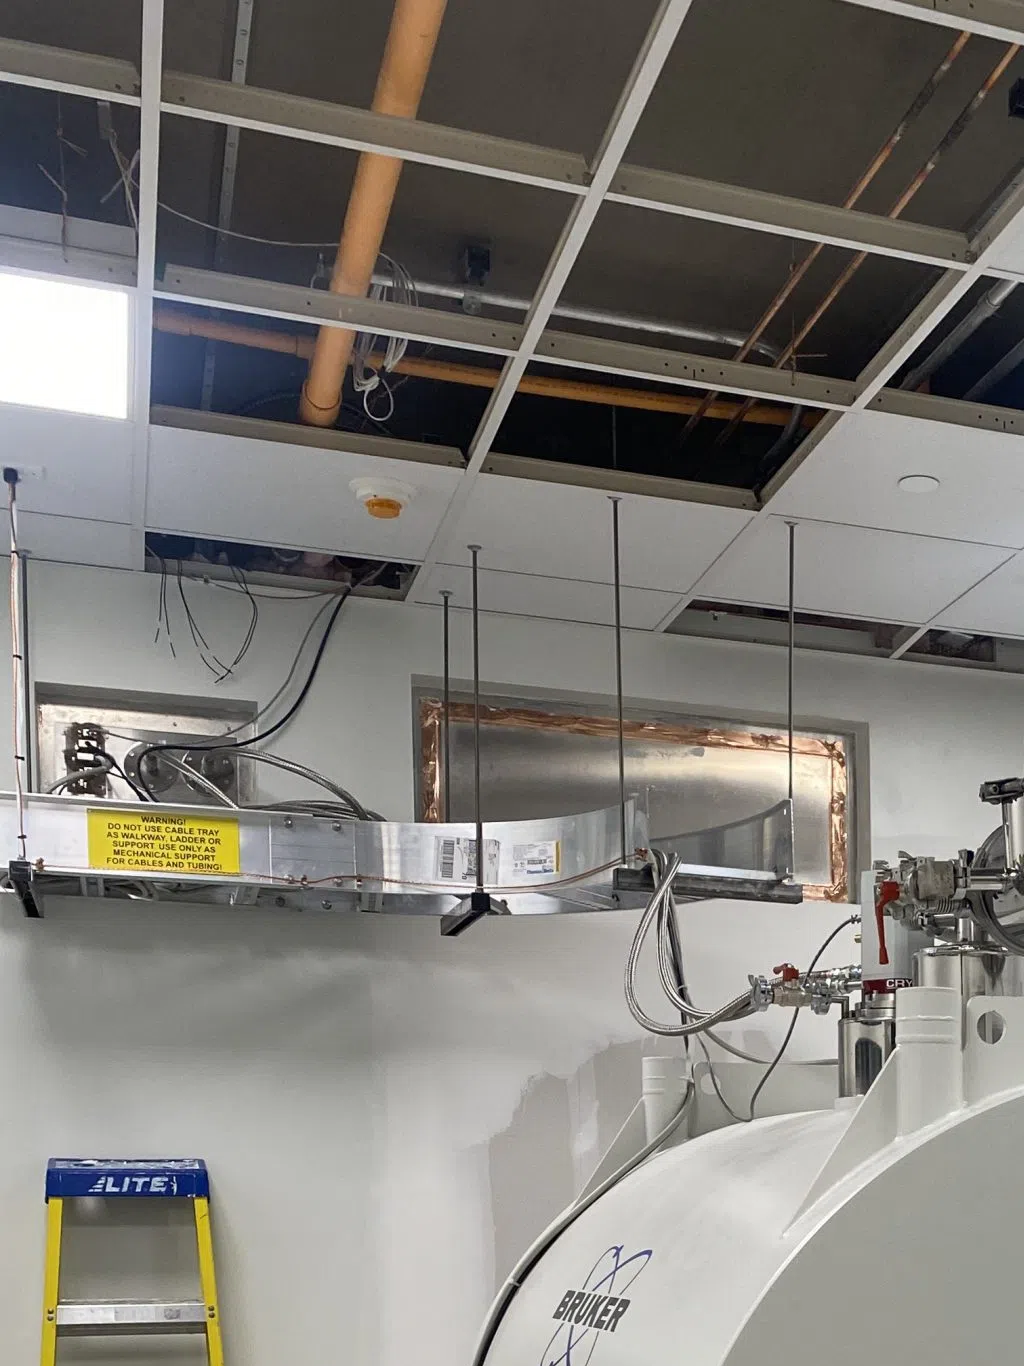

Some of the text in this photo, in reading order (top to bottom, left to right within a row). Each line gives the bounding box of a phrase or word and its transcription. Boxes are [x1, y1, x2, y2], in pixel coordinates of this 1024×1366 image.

[107, 822, 121, 830] DO
[141, 816, 185, 825] WARNING!
[106, 831, 119, 839] AS
[170, 836, 205, 844] LADDER
[207, 837, 222, 845] OR
[178, 844, 203, 853] ONLY
[113, 849, 216, 861] MECHANICAL SUPPORT
[106, 856, 125, 865] FOR
[128, 859, 163, 867] CABLES
[187, 862, 222, 870] TUBING!
[552, 1290, 631, 1332] BRUKER
